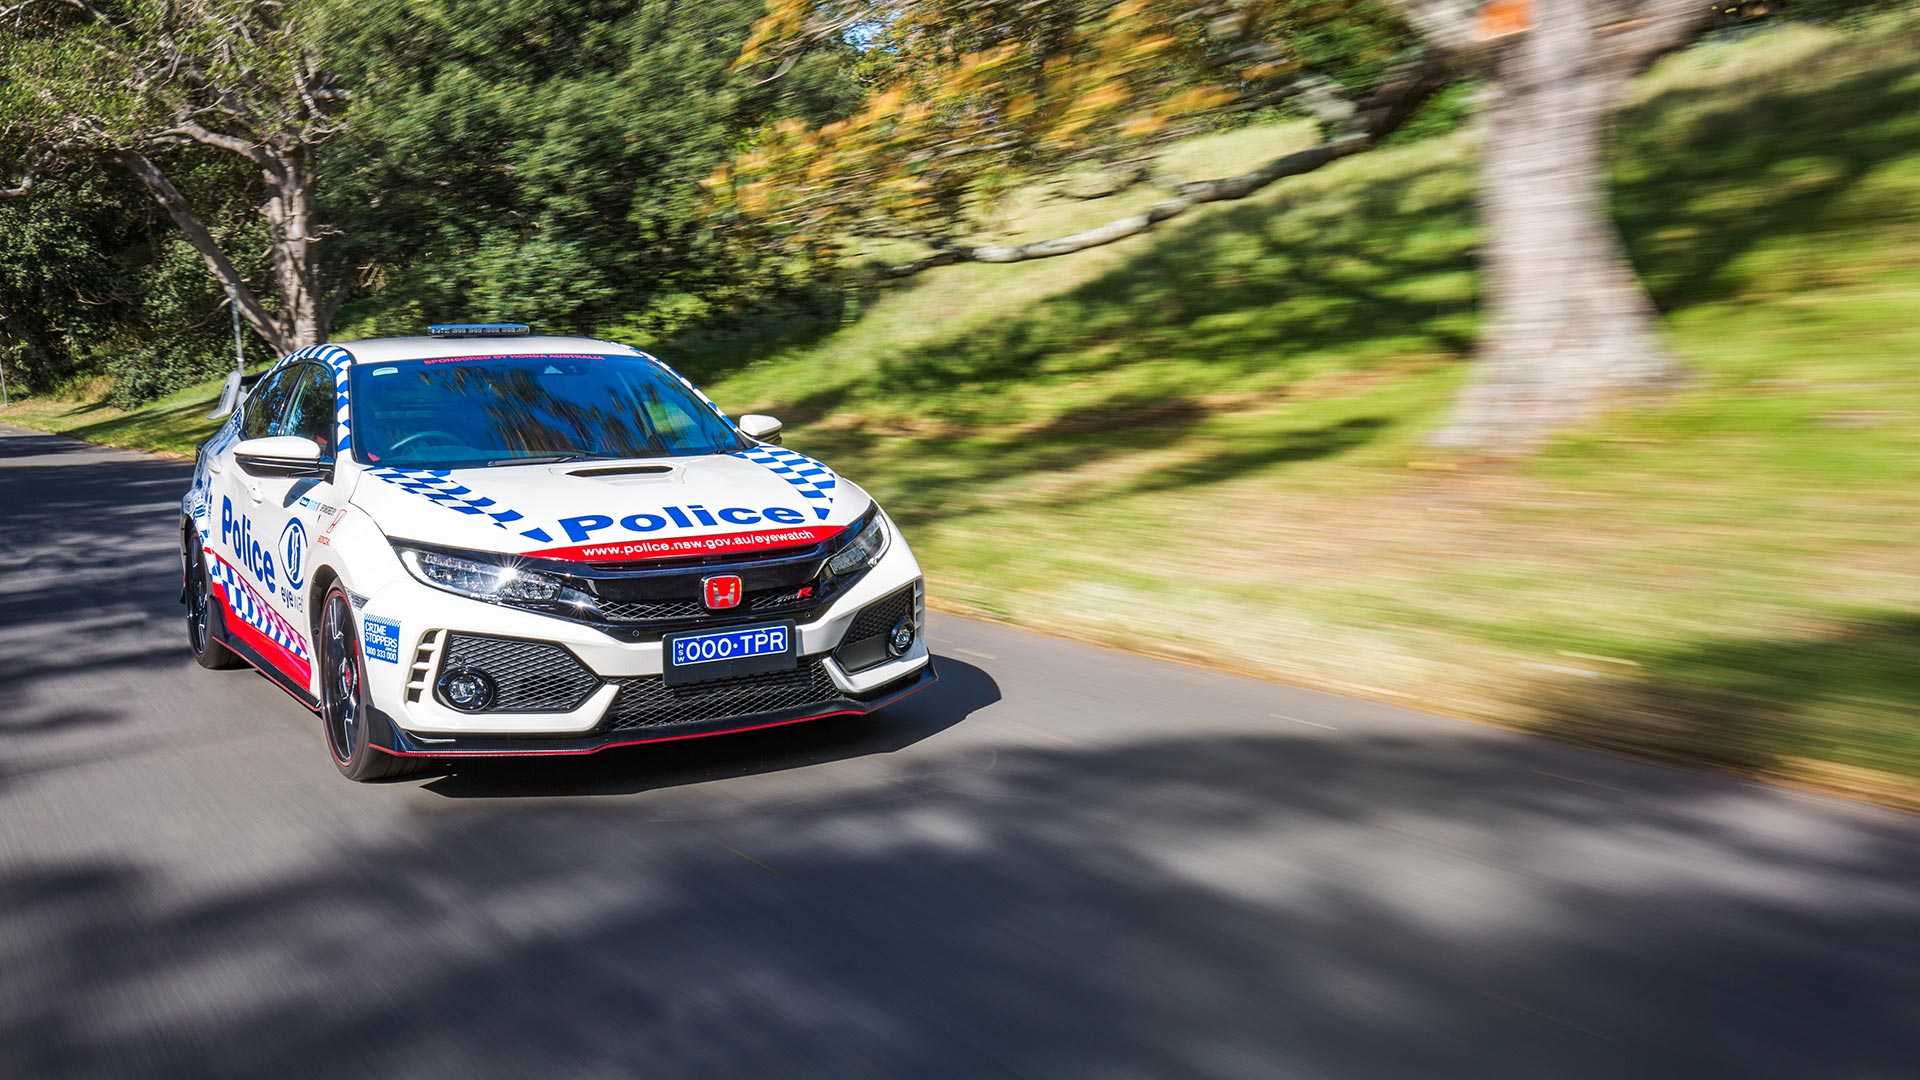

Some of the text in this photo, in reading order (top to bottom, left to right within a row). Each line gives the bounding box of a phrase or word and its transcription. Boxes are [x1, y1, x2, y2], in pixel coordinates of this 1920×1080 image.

[558, 505, 806, 543] Police
[222, 495, 276, 593] Police
[583, 529, 815, 557] www.police.nsw.gov.au/eyewatch
[365, 622, 387, 636] CRIME
[365, 632, 398, 648] STOPPERS
